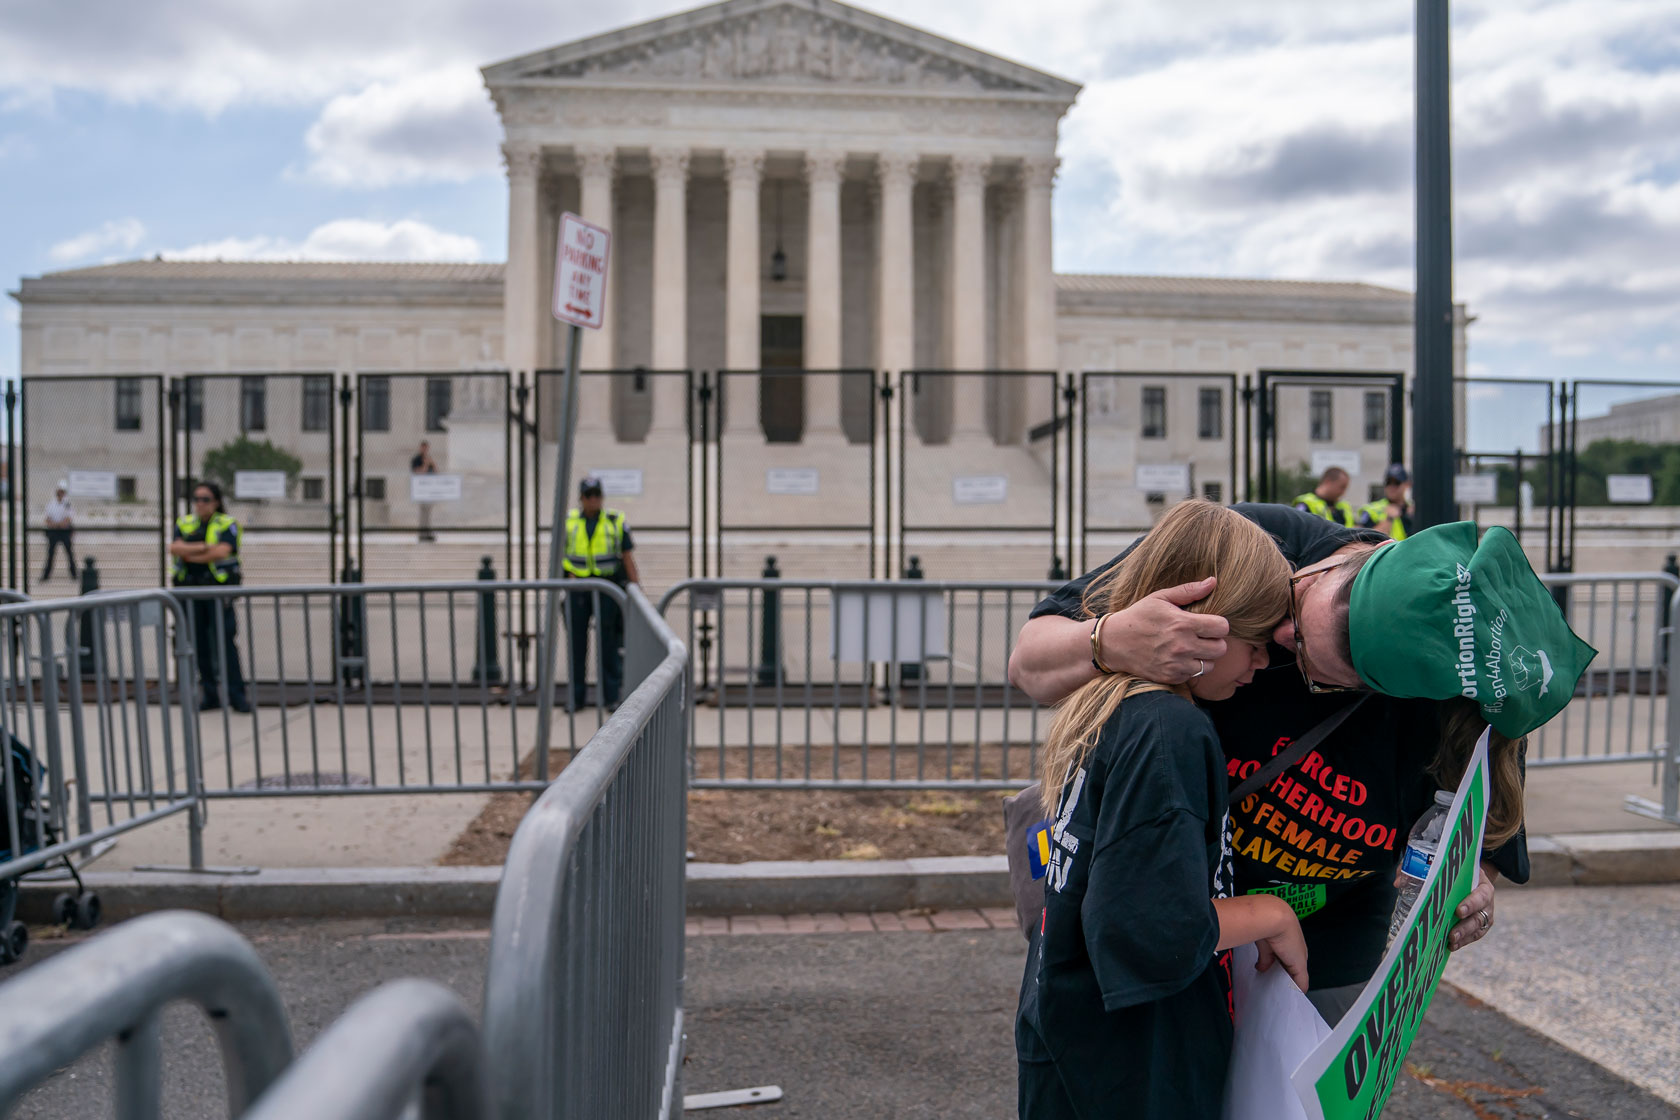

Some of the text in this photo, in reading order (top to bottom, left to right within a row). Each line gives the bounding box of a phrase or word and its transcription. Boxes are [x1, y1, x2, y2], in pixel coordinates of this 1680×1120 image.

[576, 228, 594, 250] NO
[1483, 608, 1508, 713] #Gen4Abortion
[1253, 802, 1363, 865] FEMALE
[1344, 792, 1474, 1101] OVERTURN
